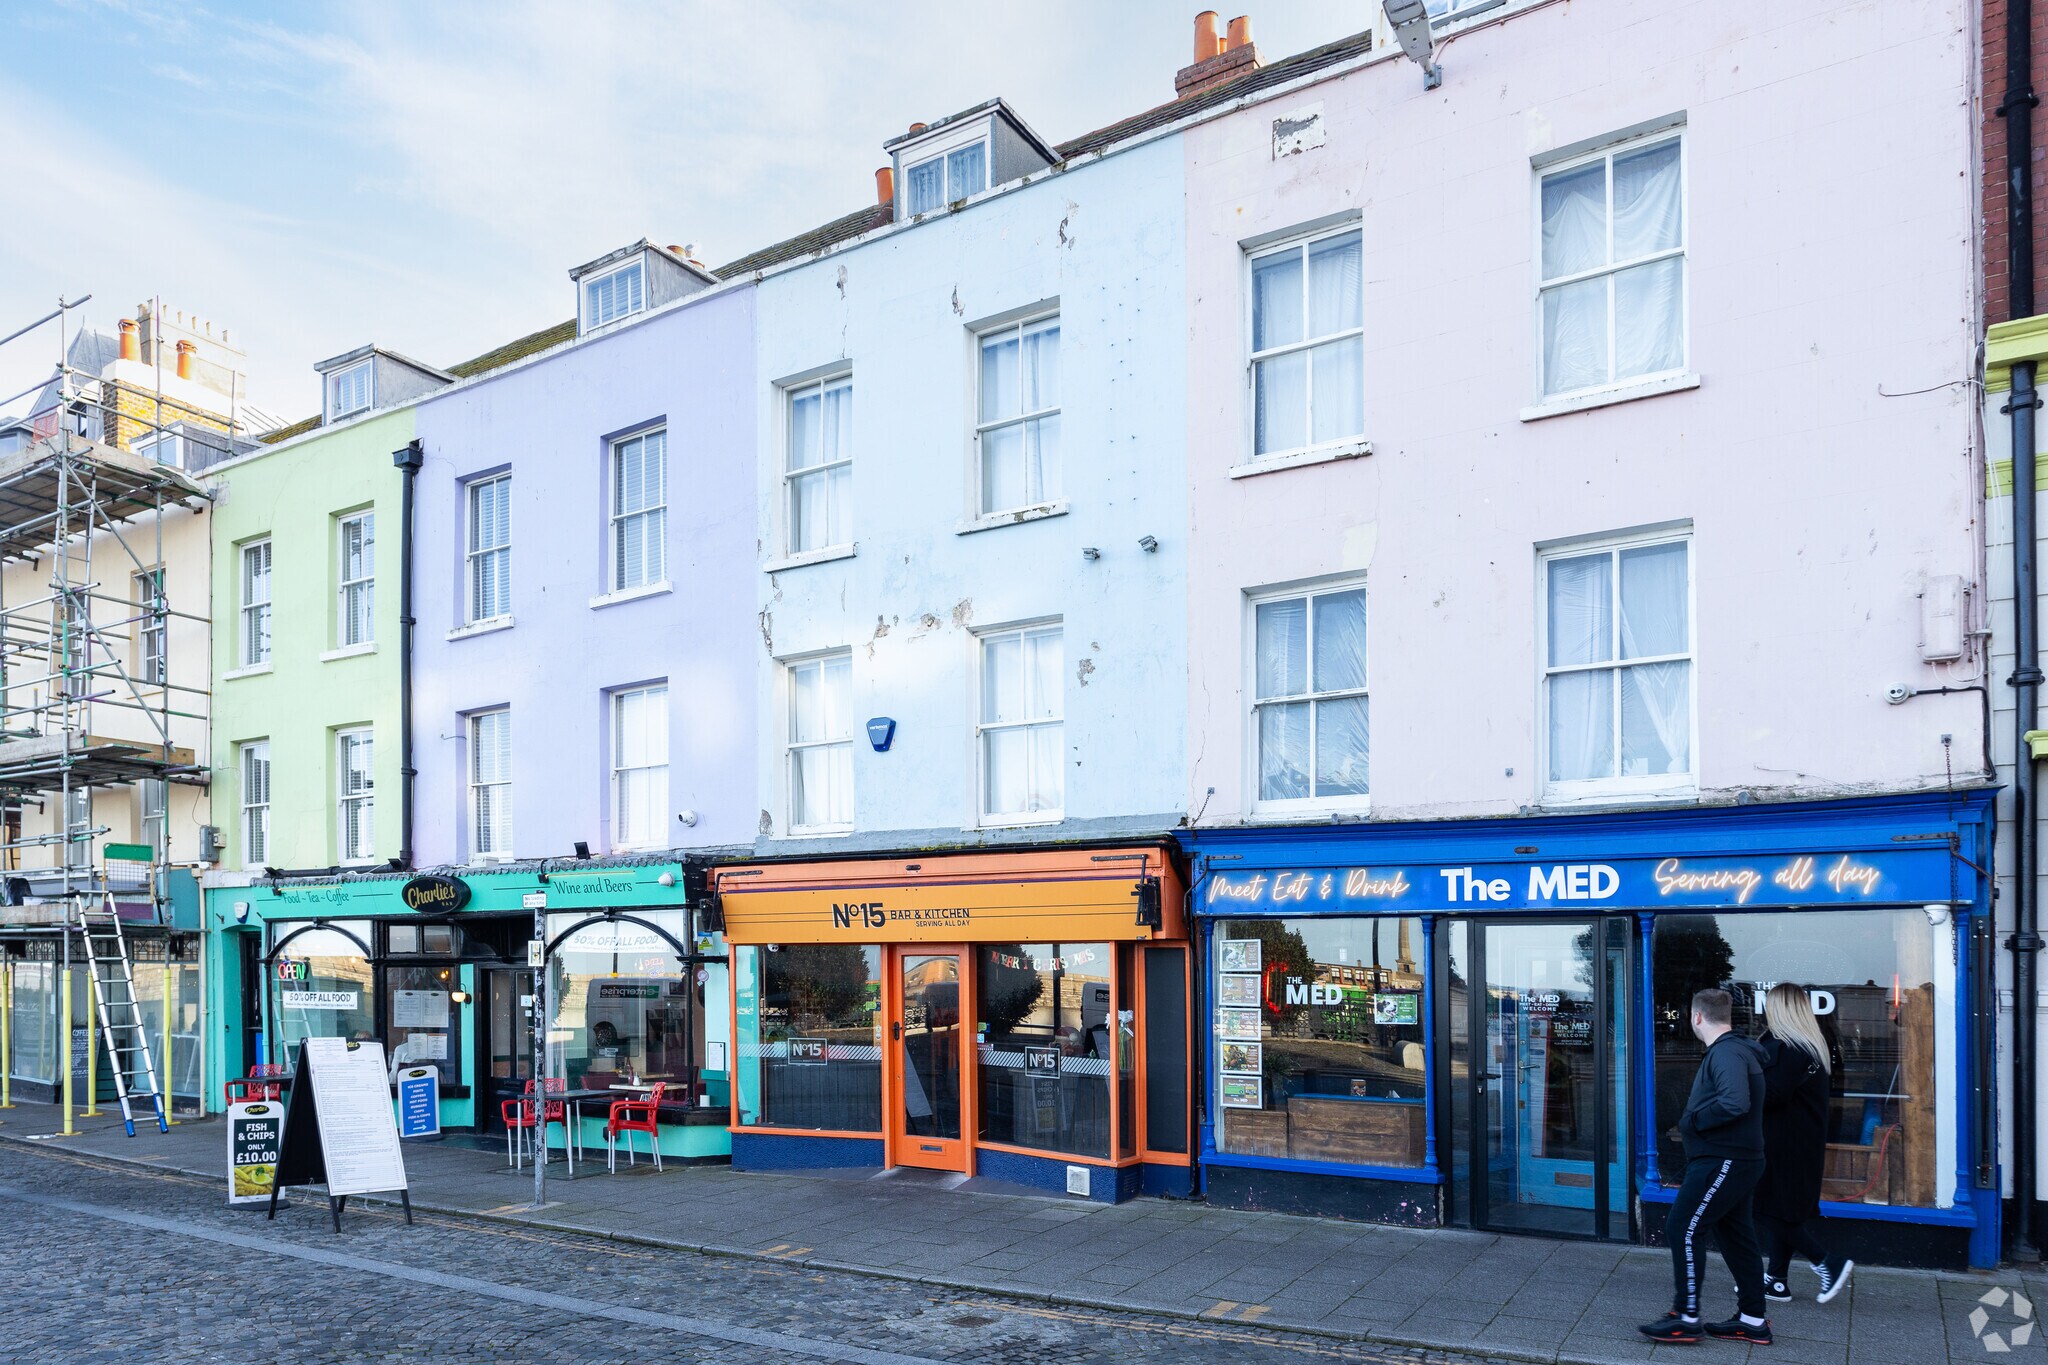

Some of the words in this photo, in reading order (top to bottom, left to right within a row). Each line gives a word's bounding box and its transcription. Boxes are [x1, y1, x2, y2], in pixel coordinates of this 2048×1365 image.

[1209, 874, 1268, 903] Meet
[1272, 872, 1314, 900] Eat
[1320, 874, 1332, 900] &
[1346, 868, 1410, 898] Drink
[1440, 866, 1511, 902] The
[1528, 864, 1620, 900] MED
[1654, 858, 1762, 904] Serving
[1775, 856, 1814, 890] all
[1828, 855, 1880, 894] day
[554, 880, 581, 896] Wine
[583, 879, 603, 894] and
[605, 878, 632, 894] Beers
[281, 891, 301, 904] Food
[305, 891, 320, 904] Tea
[326, 888, 350, 907] Coffee
[408, 882, 456, 908] Charlie's
[890, 909, 912, 920] BAR
[914, 909, 922, 919] &
[925, 908, 970, 919] KITCHEN
[574, 935, 595, 945] 50%
[597, 936, 616, 946] OFF
[634, 935, 659, 946] FOOD
[278, 962, 306, 980] OPEN
[1286, 976, 1303, 984] THE
[289, 993, 304, 1002] 50%
[305, 993, 317, 1002] OFF
[318, 993, 331, 1002] ALL
[332, 994, 351, 1002] FOOD
[1286, 984, 1343, 1005] MED
[1519, 994, 1536, 1002] The
[1539, 994, 1560, 1003] MED
[1554, 1022, 1569, 1030] The
[246, 1123, 267, 1132] FISH
[238, 1132, 246, 1141] &
[247, 1131, 275, 1140] CHIPS
[236, 1151, 277, 1164] £10.00
